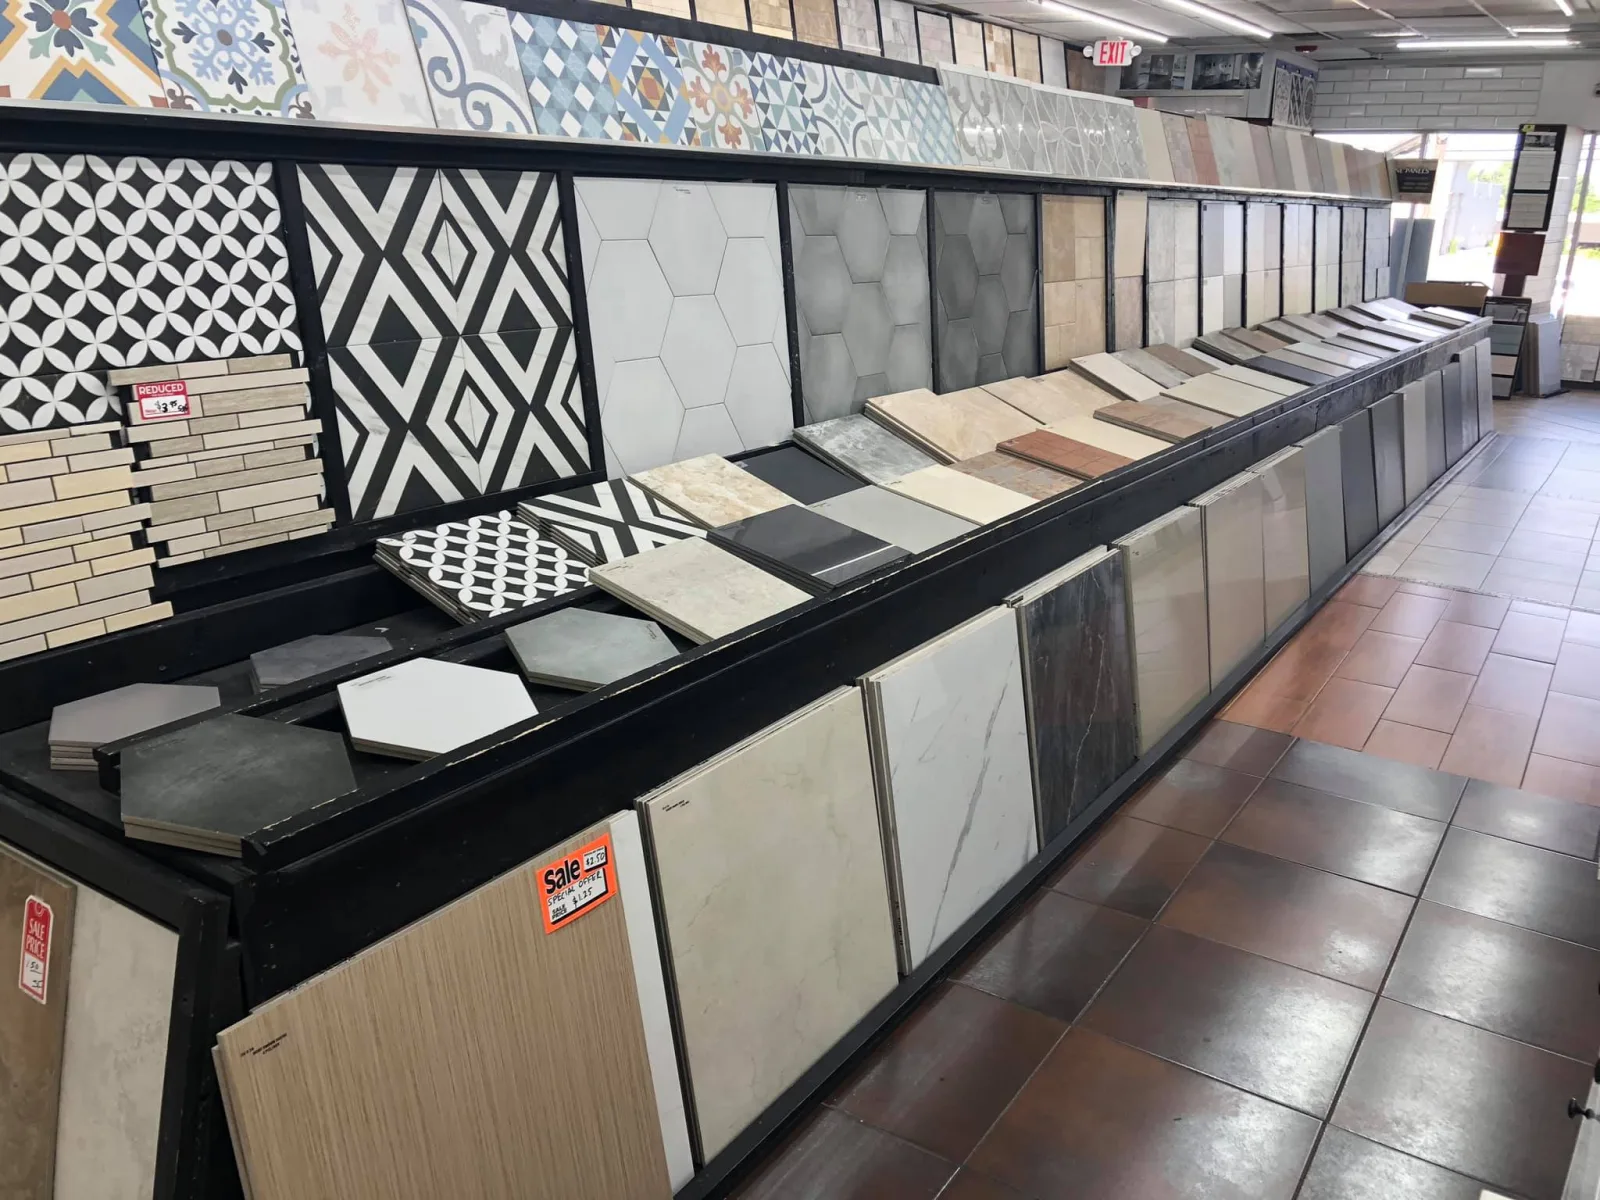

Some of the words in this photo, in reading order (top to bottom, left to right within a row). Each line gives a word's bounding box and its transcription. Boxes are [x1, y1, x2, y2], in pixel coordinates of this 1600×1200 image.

[1099, 41, 1128, 64] EXIT
[138, 383, 184, 395] REDUCED
[585, 852, 605, 867] $2.50
[544, 859, 581, 894] Sale
[548, 886, 576, 907] SPECIAL
[578, 870, 602, 888] OFFER
[29, 918, 45, 941] SALE
[26, 934, 45, 960] PRICE
